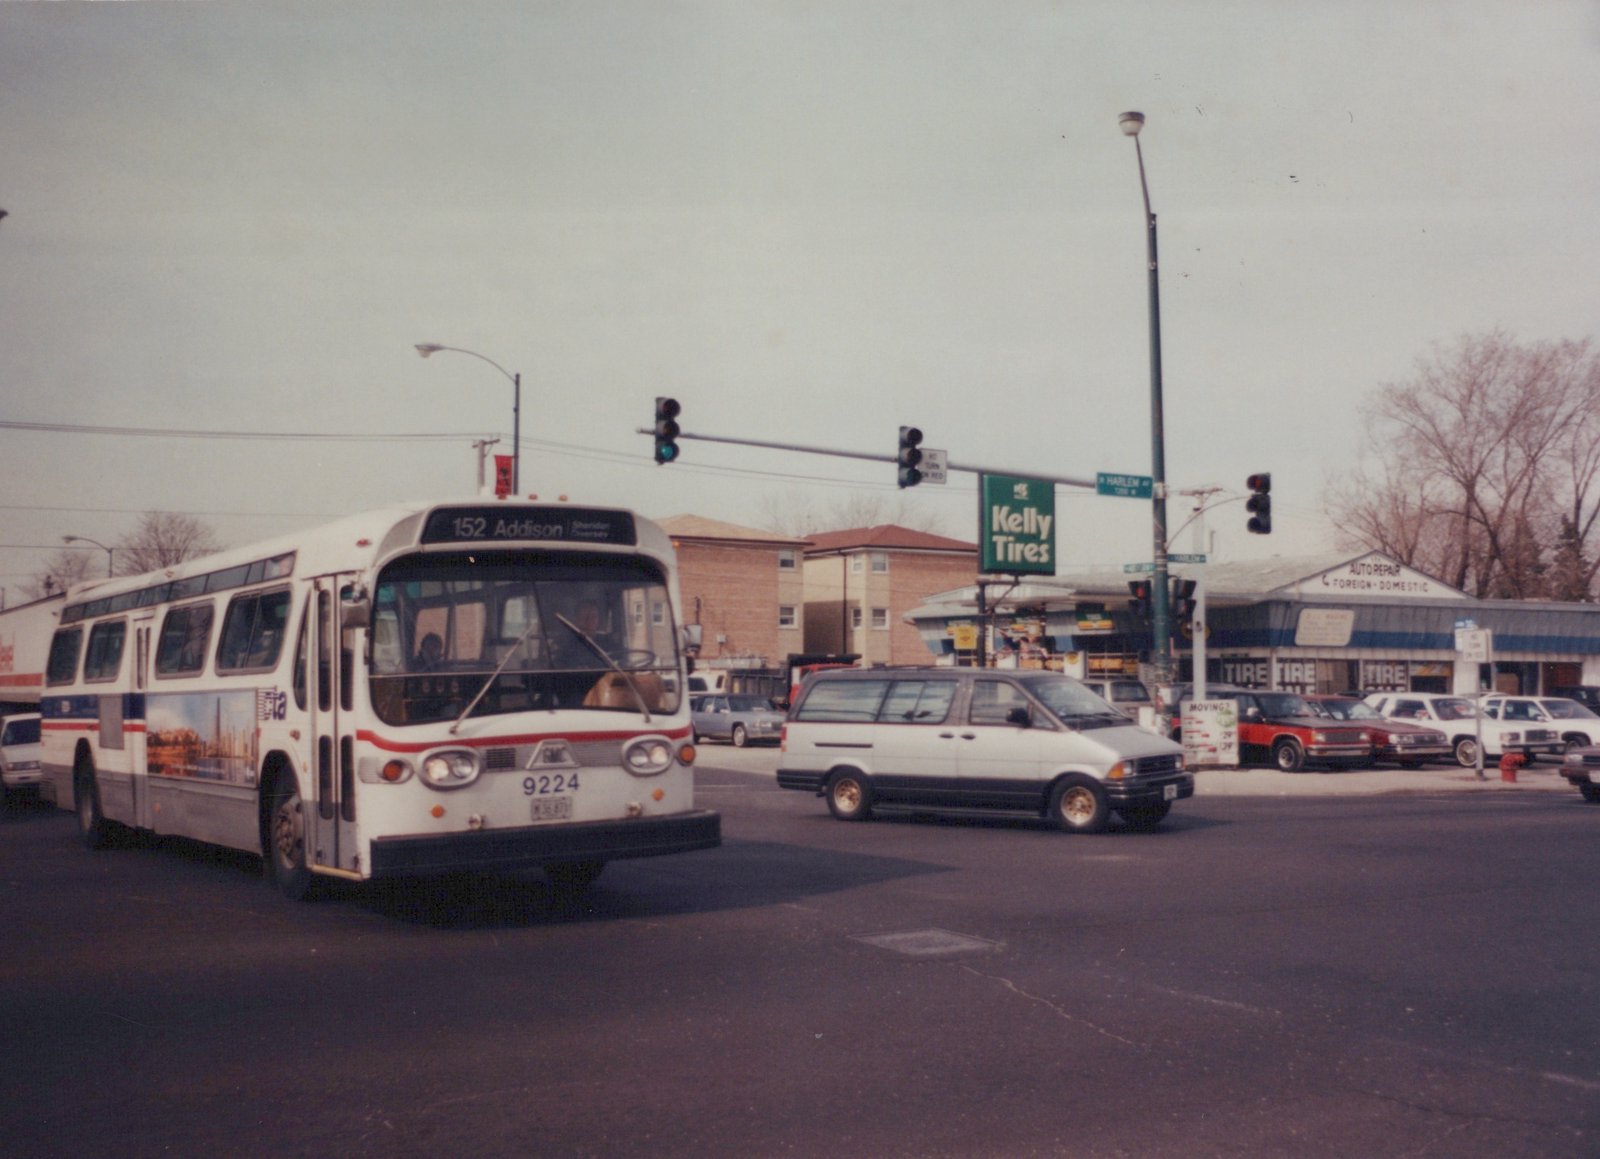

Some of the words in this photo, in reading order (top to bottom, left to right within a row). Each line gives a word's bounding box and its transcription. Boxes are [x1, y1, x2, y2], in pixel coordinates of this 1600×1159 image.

[1107, 476, 1140, 488] HARLEM
[453, 517, 487, 538] 152
[494, 519, 563, 538] Addison
[992, 505, 1052, 540] Kelly
[992, 535, 1050, 563] Tires
[1379, 581, 1429, 592] DOMESTIC
[1224, 663, 1268, 683] TIRE
[1275, 663, 1315, 683] TIRE
[1365, 664, 1406, 684] TIRE
[523, 773, 579, 796] 9224
